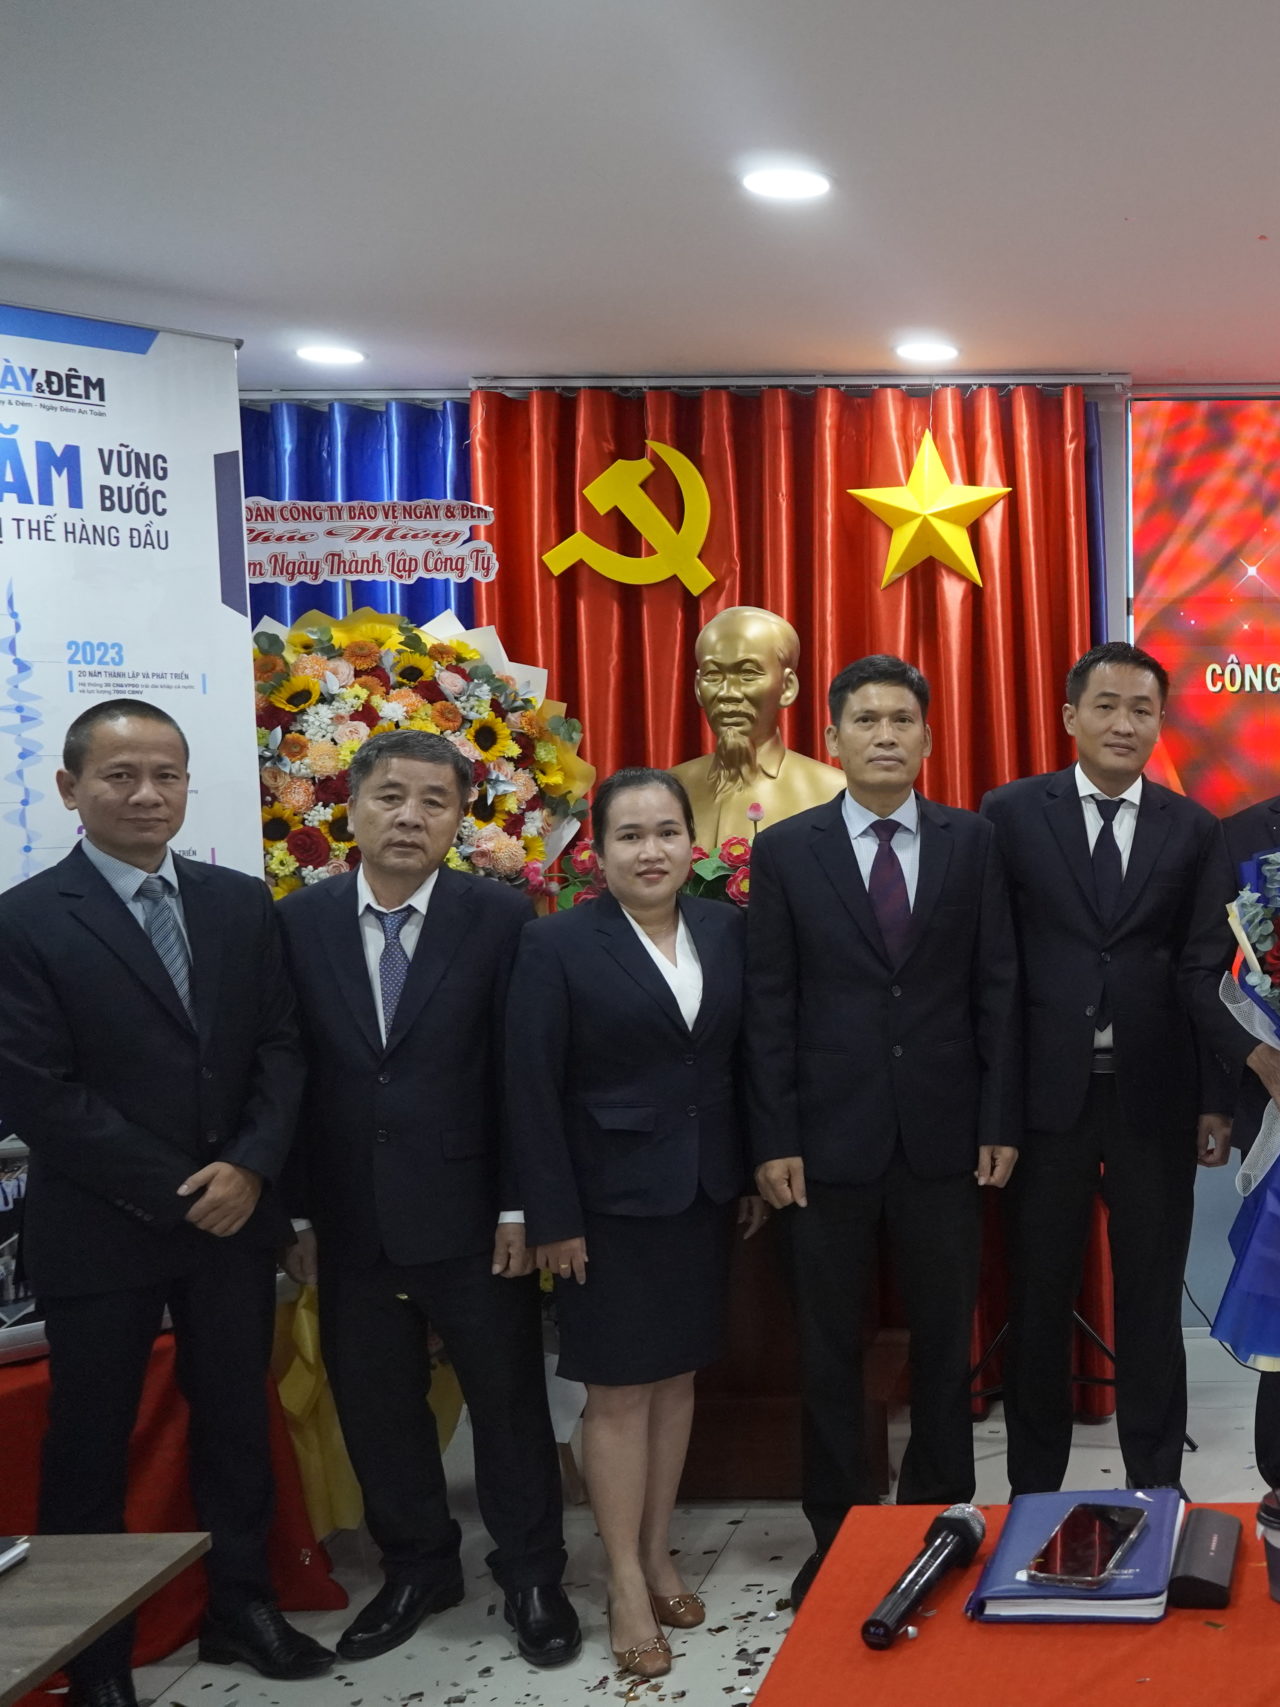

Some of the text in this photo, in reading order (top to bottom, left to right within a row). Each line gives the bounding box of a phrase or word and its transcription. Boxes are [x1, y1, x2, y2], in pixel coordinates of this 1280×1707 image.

[98, 443, 168, 481] VỮNG
[100, 482, 167, 516] BƯỚC
[280, 503, 323, 521] CÔNG
[327, 505, 343, 521] TY
[348, 502, 377, 520] BẢO
[382, 502, 398, 524] VỆ
[403, 501, 440, 520] NGÀY
[445, 504, 456, 519] &
[11, 513, 57, 542] THẾ
[64, 518, 120, 547] HÀNG
[129, 521, 169, 550] ĐẦU
[269, 552, 321, 581] Ngày
[325, 552, 383, 575] Thành
[387, 551, 418, 579] Lập
[424, 550, 465, 578] Công
[470, 549, 491, 578] Ty
[66, 640, 124, 666] 2023
[78, 670, 86, 678] 20
